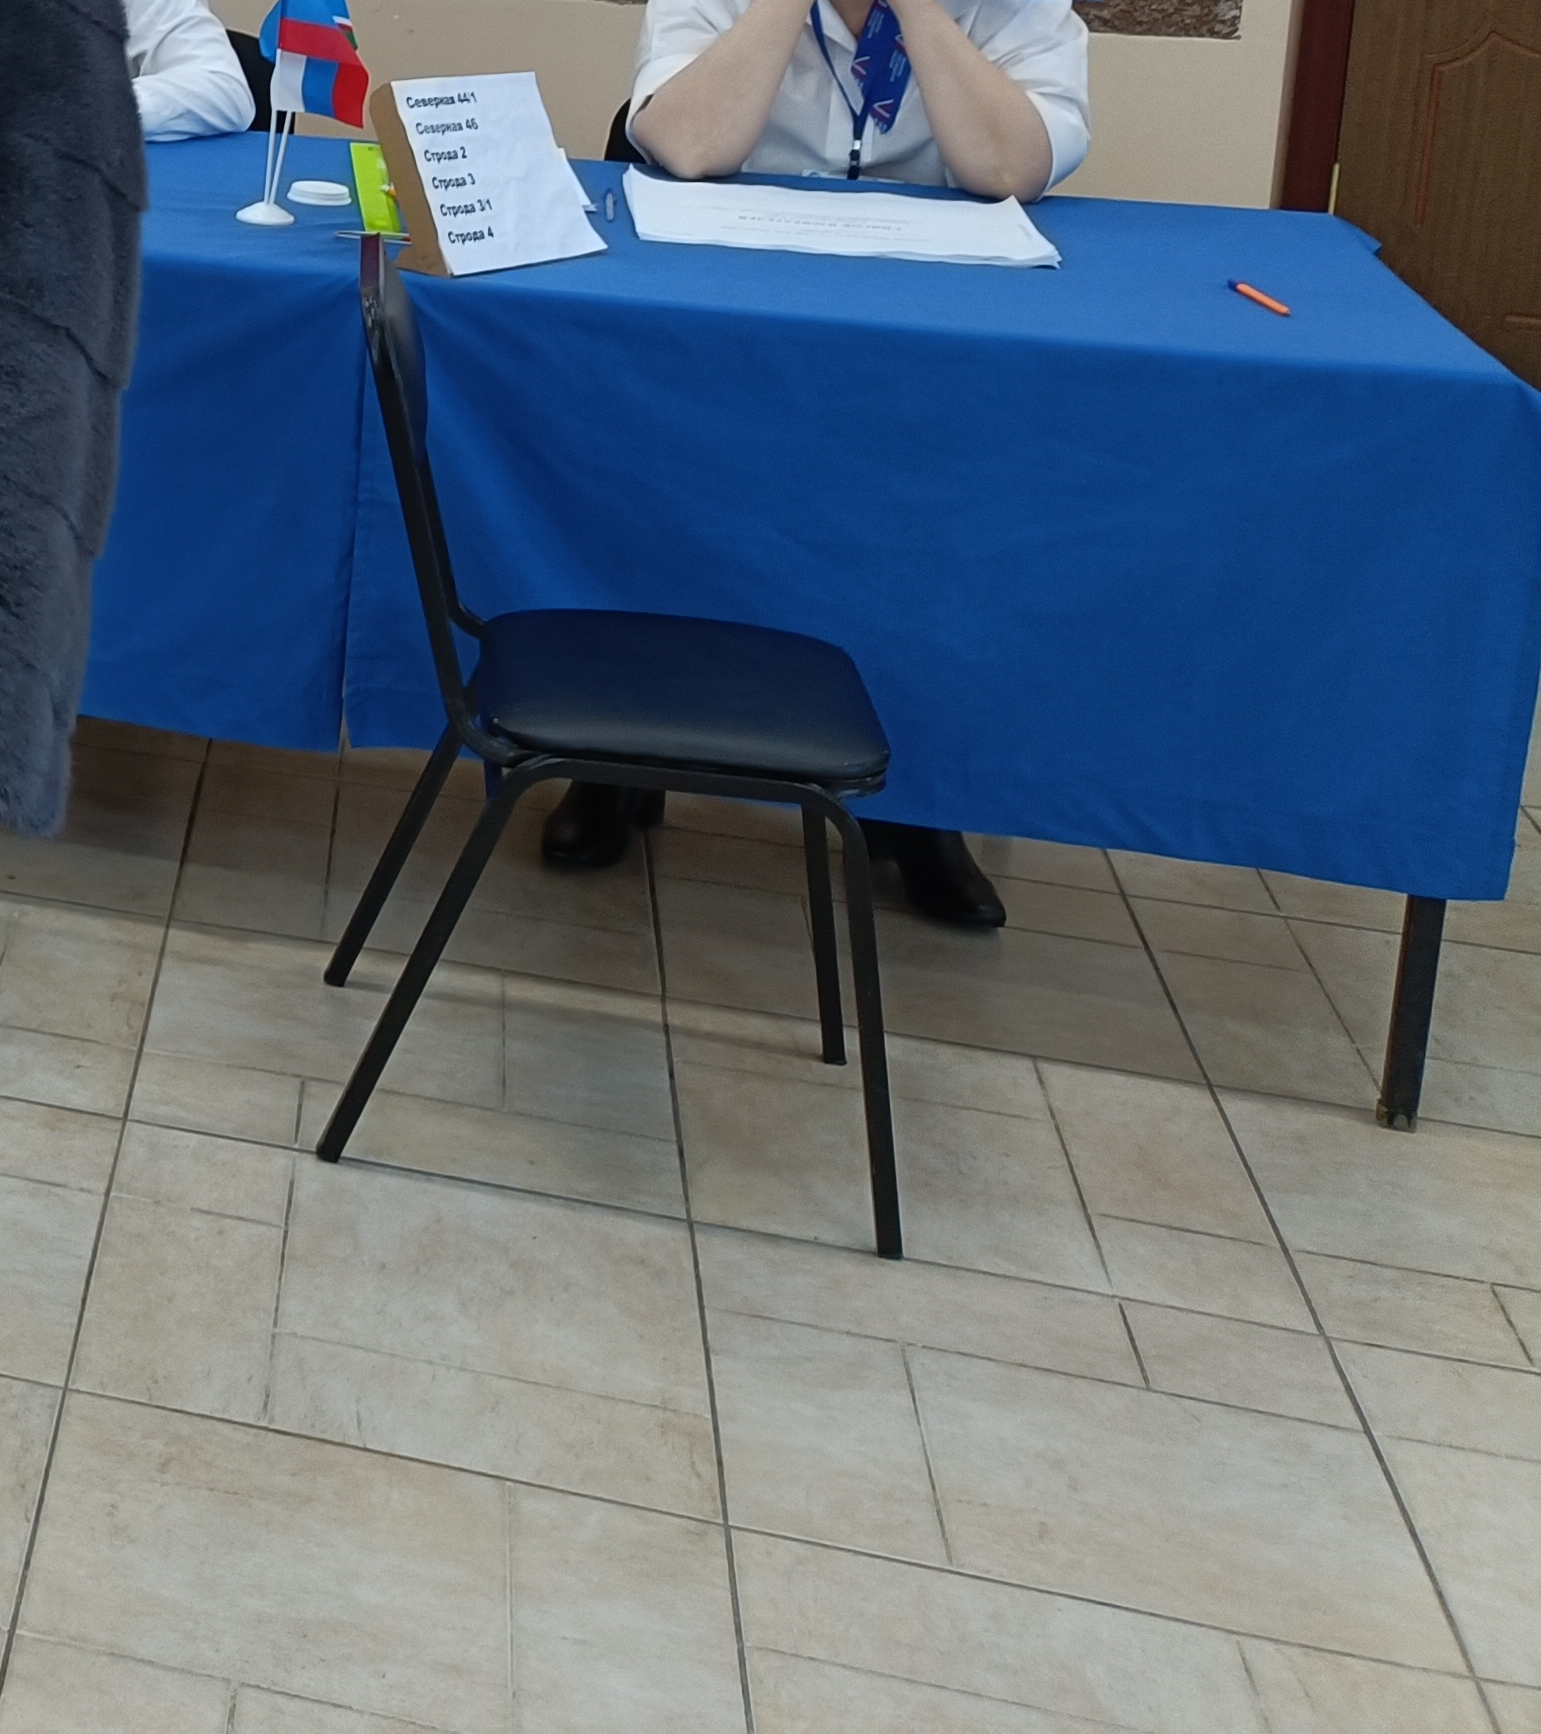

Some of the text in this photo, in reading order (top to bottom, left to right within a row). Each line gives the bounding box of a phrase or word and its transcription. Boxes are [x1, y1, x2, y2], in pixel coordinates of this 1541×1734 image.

[406, 95, 455, 109] Северная
[416, 122, 463, 135] Северная
[424, 146, 467, 162] Строда 2
[432, 173, 476, 190] Строда 3
[440, 203, 476, 217] Строда
[448, 227, 494, 245] Строда 4
